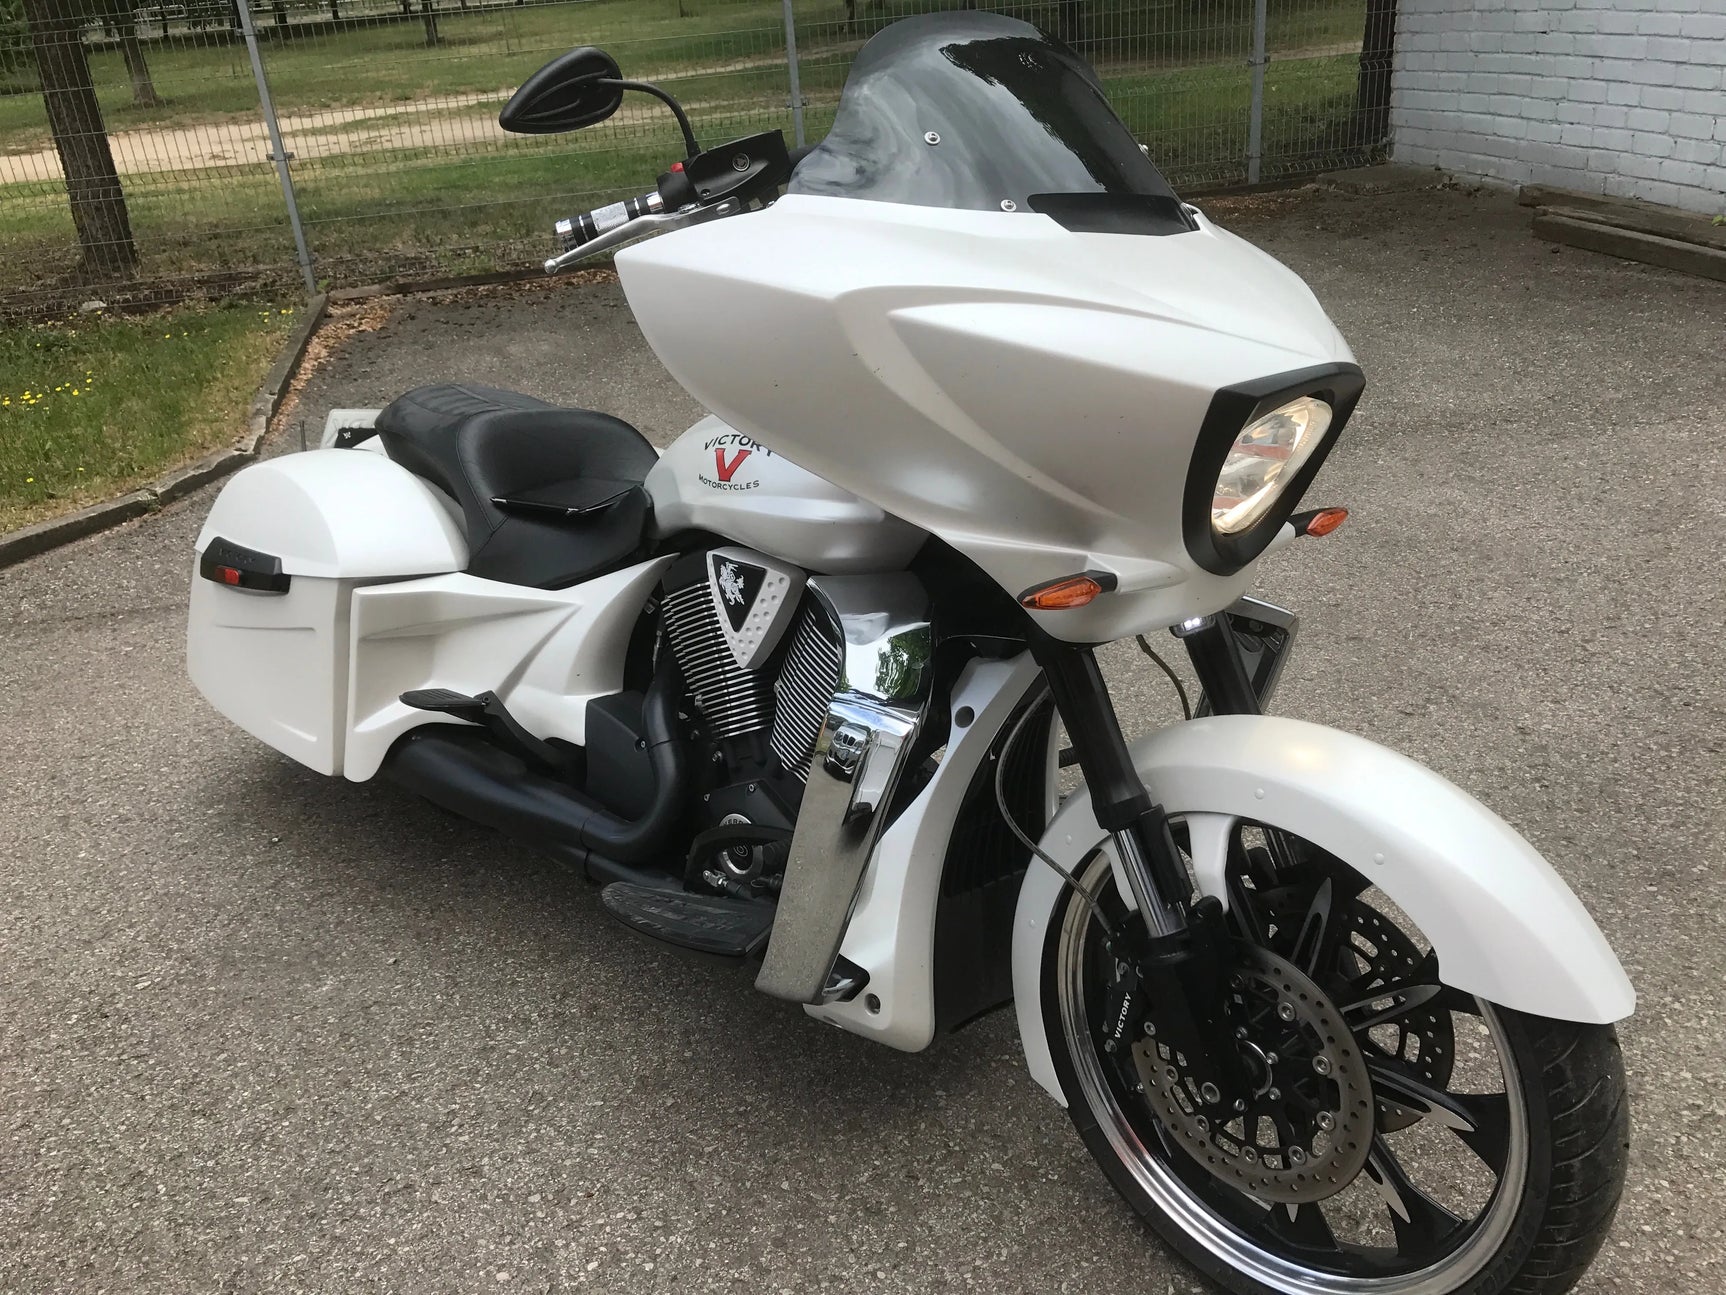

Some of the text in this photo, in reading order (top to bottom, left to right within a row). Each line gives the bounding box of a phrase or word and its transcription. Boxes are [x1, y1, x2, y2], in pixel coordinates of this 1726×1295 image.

[698, 473, 760, 491] MOTORCYCLES
[714, 447, 753, 482] V
[1114, 991, 1132, 1039] VICTORY
